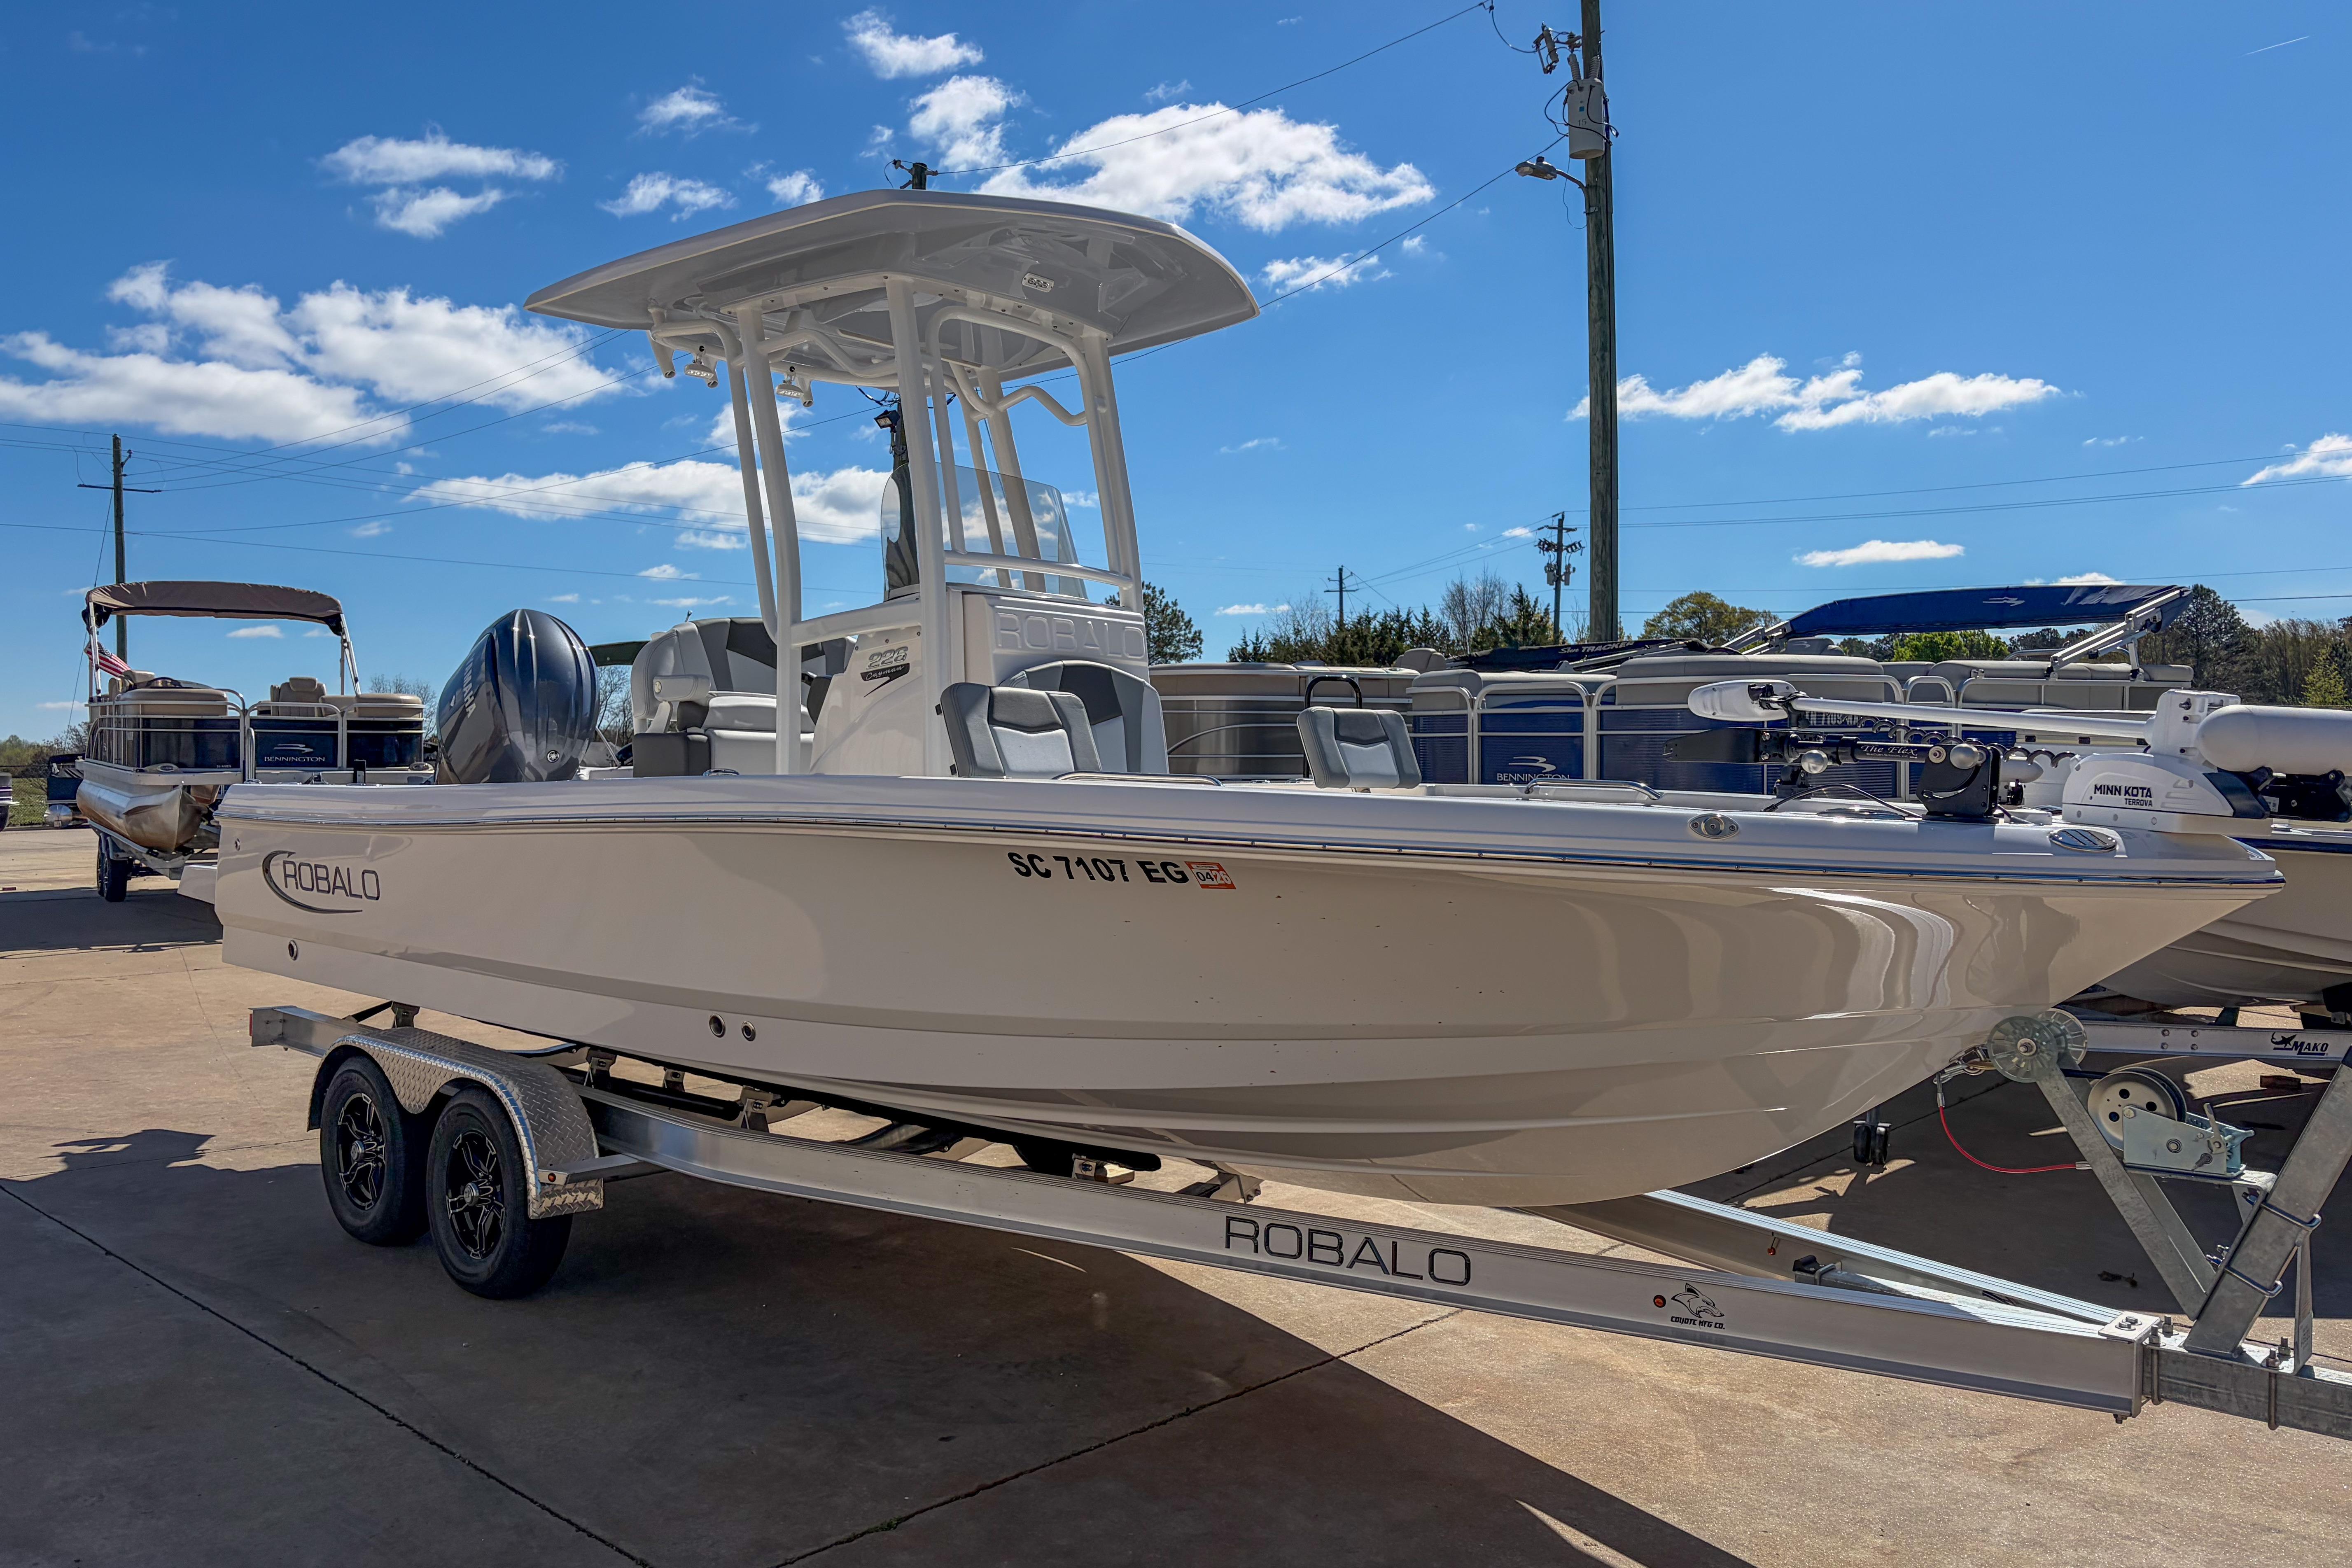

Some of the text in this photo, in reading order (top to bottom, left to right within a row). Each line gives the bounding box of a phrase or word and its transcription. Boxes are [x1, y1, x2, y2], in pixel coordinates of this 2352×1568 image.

[996, 612, 1146, 659] ROBALO
[866, 646, 908, 670] 226
[866, 665, 905, 680] Cayman
[463, 653, 476, 719] YAMAHA
[1888, 747, 1918, 756] Flex
[2094, 784, 2152, 798] MINN KOTA
[2124, 798, 2153, 807] TERROVA
[1008, 852, 1190, 884] SC 7107 EG
[283, 856, 380, 901] ROBALO
[1196, 870, 1232, 884] 04 26
[2292, 1041, 2329, 1055] MAKO
[1225, 1216, 1471, 1286] ROBALO
[1670, 1316, 1697, 1325] COYOTE
